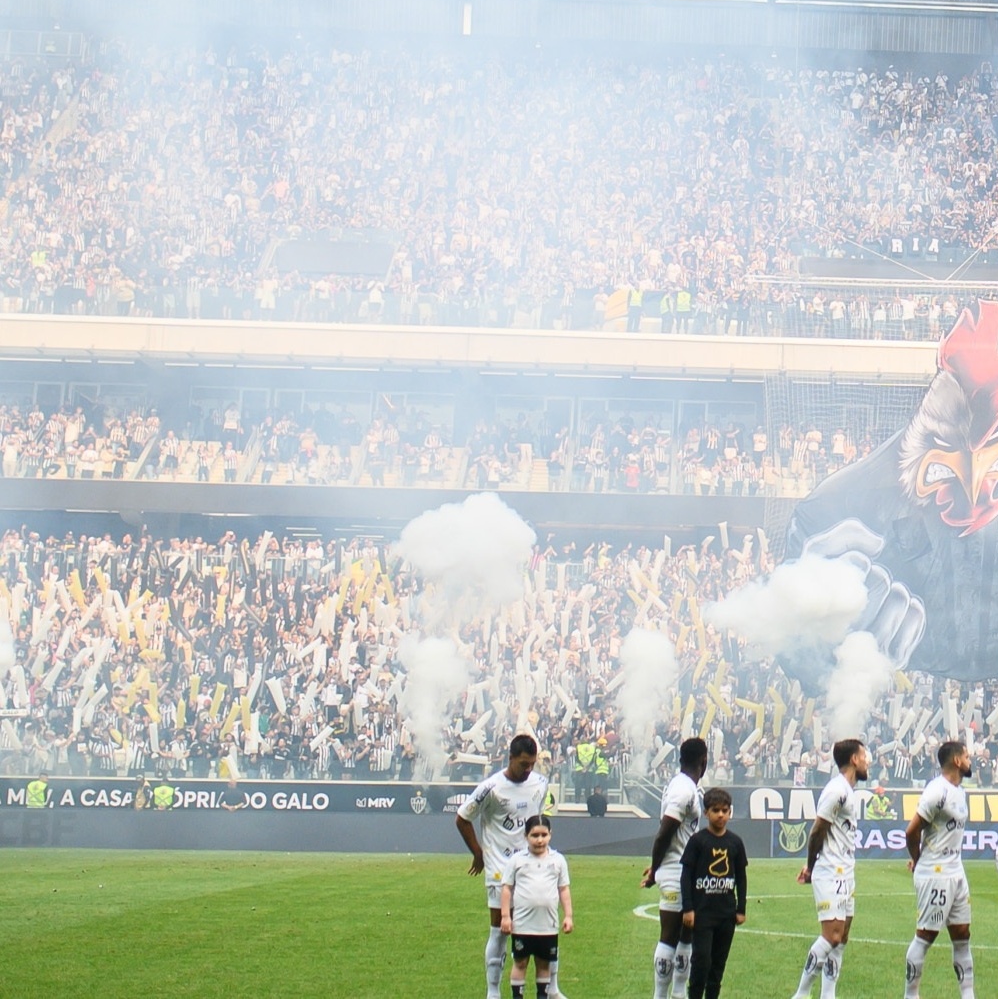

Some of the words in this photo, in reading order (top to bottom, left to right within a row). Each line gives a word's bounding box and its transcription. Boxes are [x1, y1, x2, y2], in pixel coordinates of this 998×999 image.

[60, 789, 75, 806] A
[272, 792, 330, 810] GALO
[368, 798, 395, 809] MRV
[930, 889, 947, 906] 25
